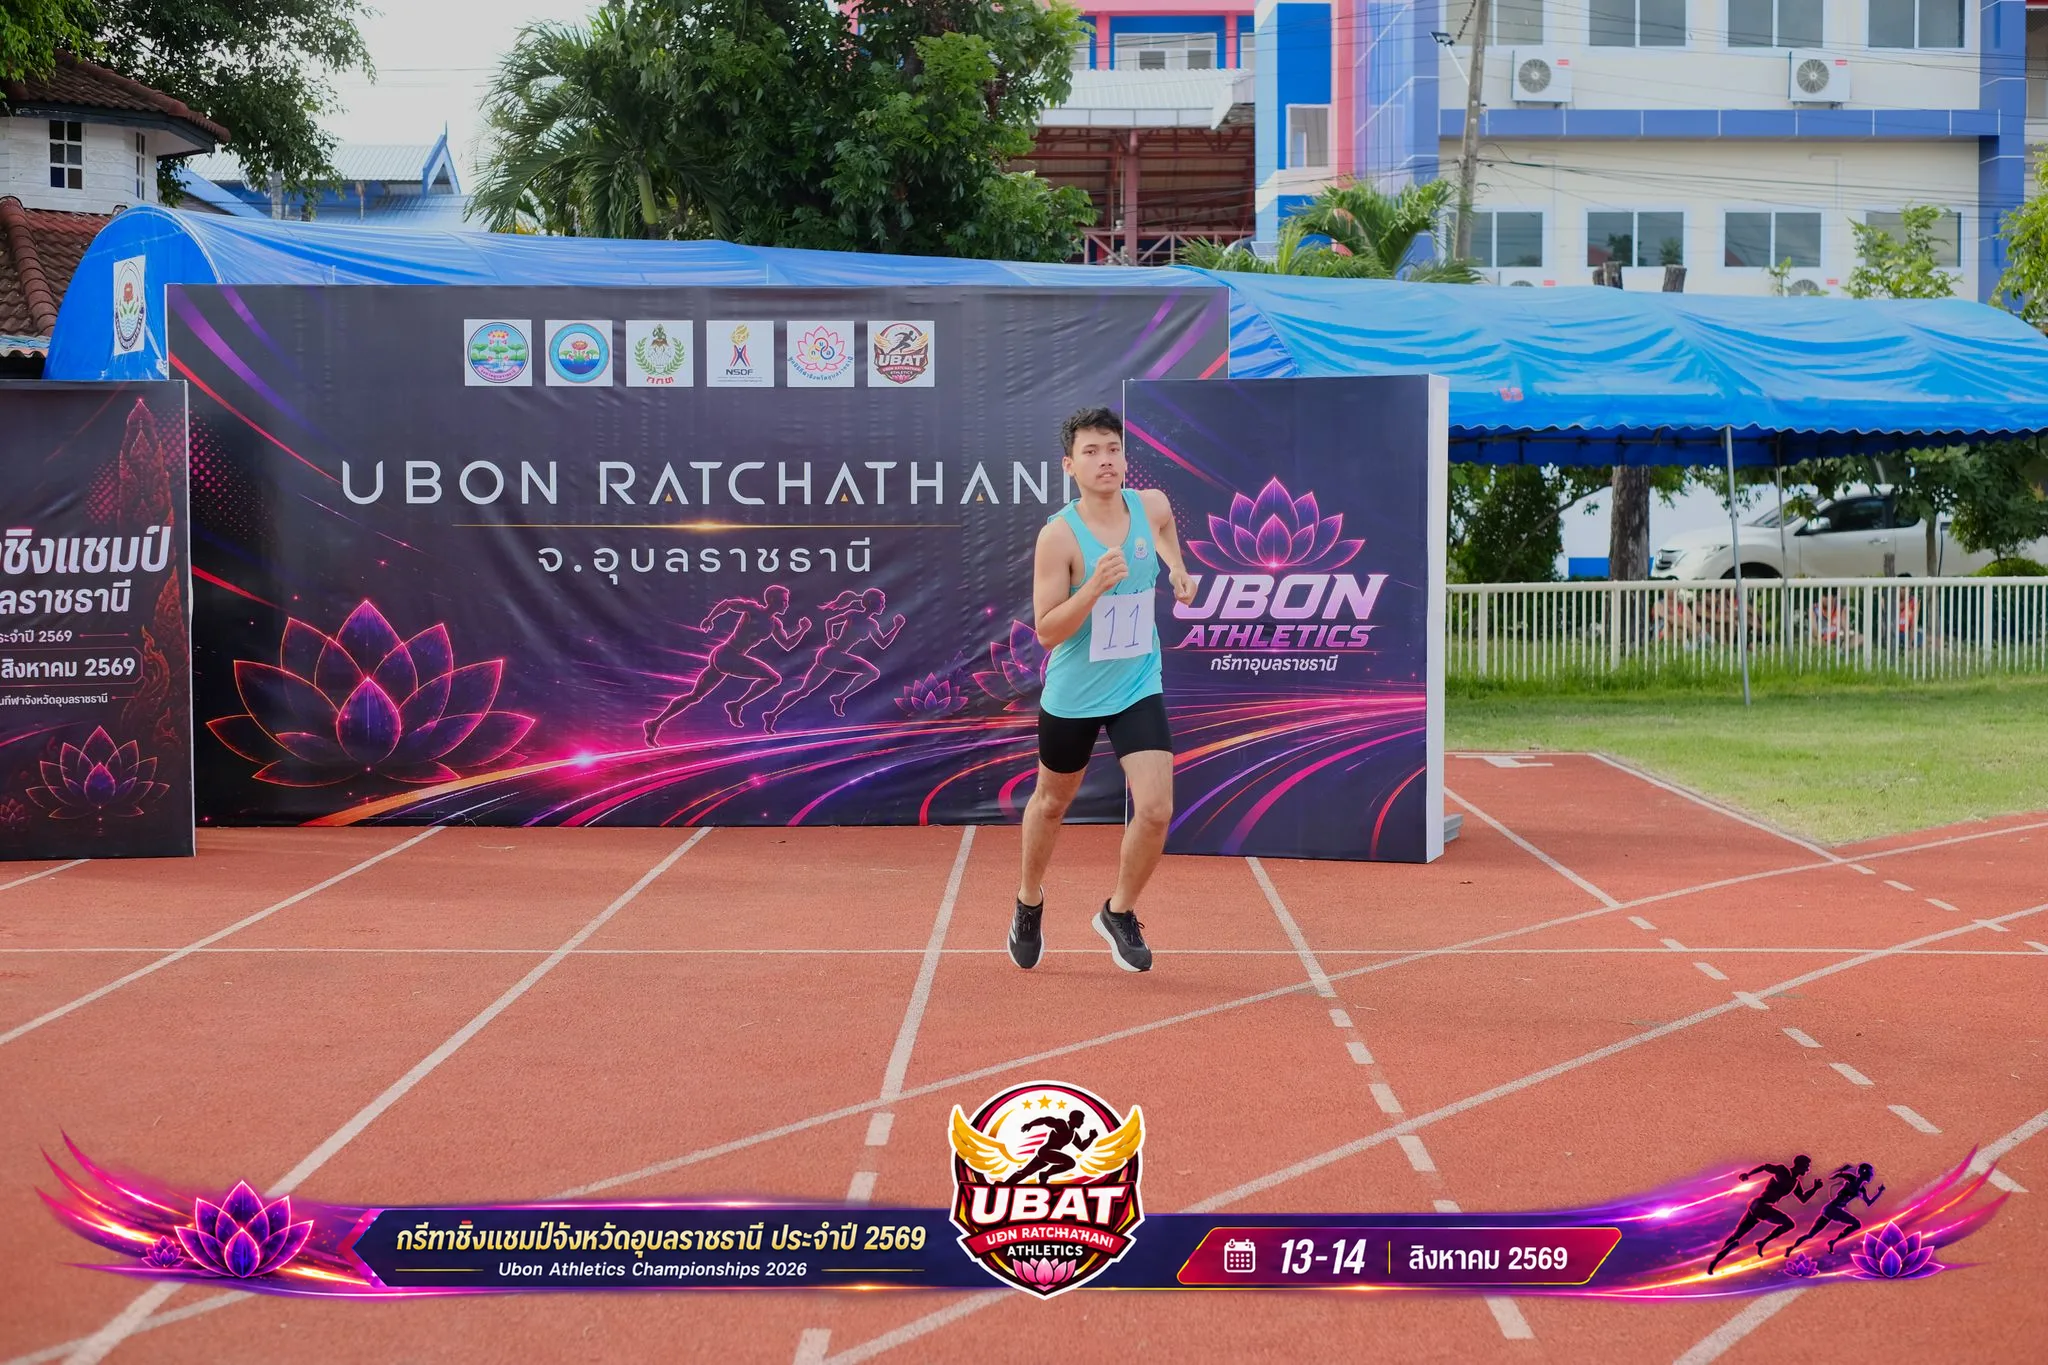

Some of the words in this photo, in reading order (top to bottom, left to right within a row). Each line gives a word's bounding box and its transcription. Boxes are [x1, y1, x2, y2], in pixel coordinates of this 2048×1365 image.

[878, 355, 924, 367] UBAT
[342, 460, 557, 505] UBON
[600, 460, 1071, 505] RATCHATHANI
[0, 525, 172, 575] ชิงแชมป์
[538, 537, 871, 585] จ.อุบลราชธานี
[1172, 573, 1390, 620] UBON
[39, 630, 73, 643] 2569
[1102, 603, 1141, 651] 11
[1176, 624, 1380, 648] ATHLETICS
[1, 658, 77, 679] สิงหาคม
[84, 657, 136, 677] 2569
